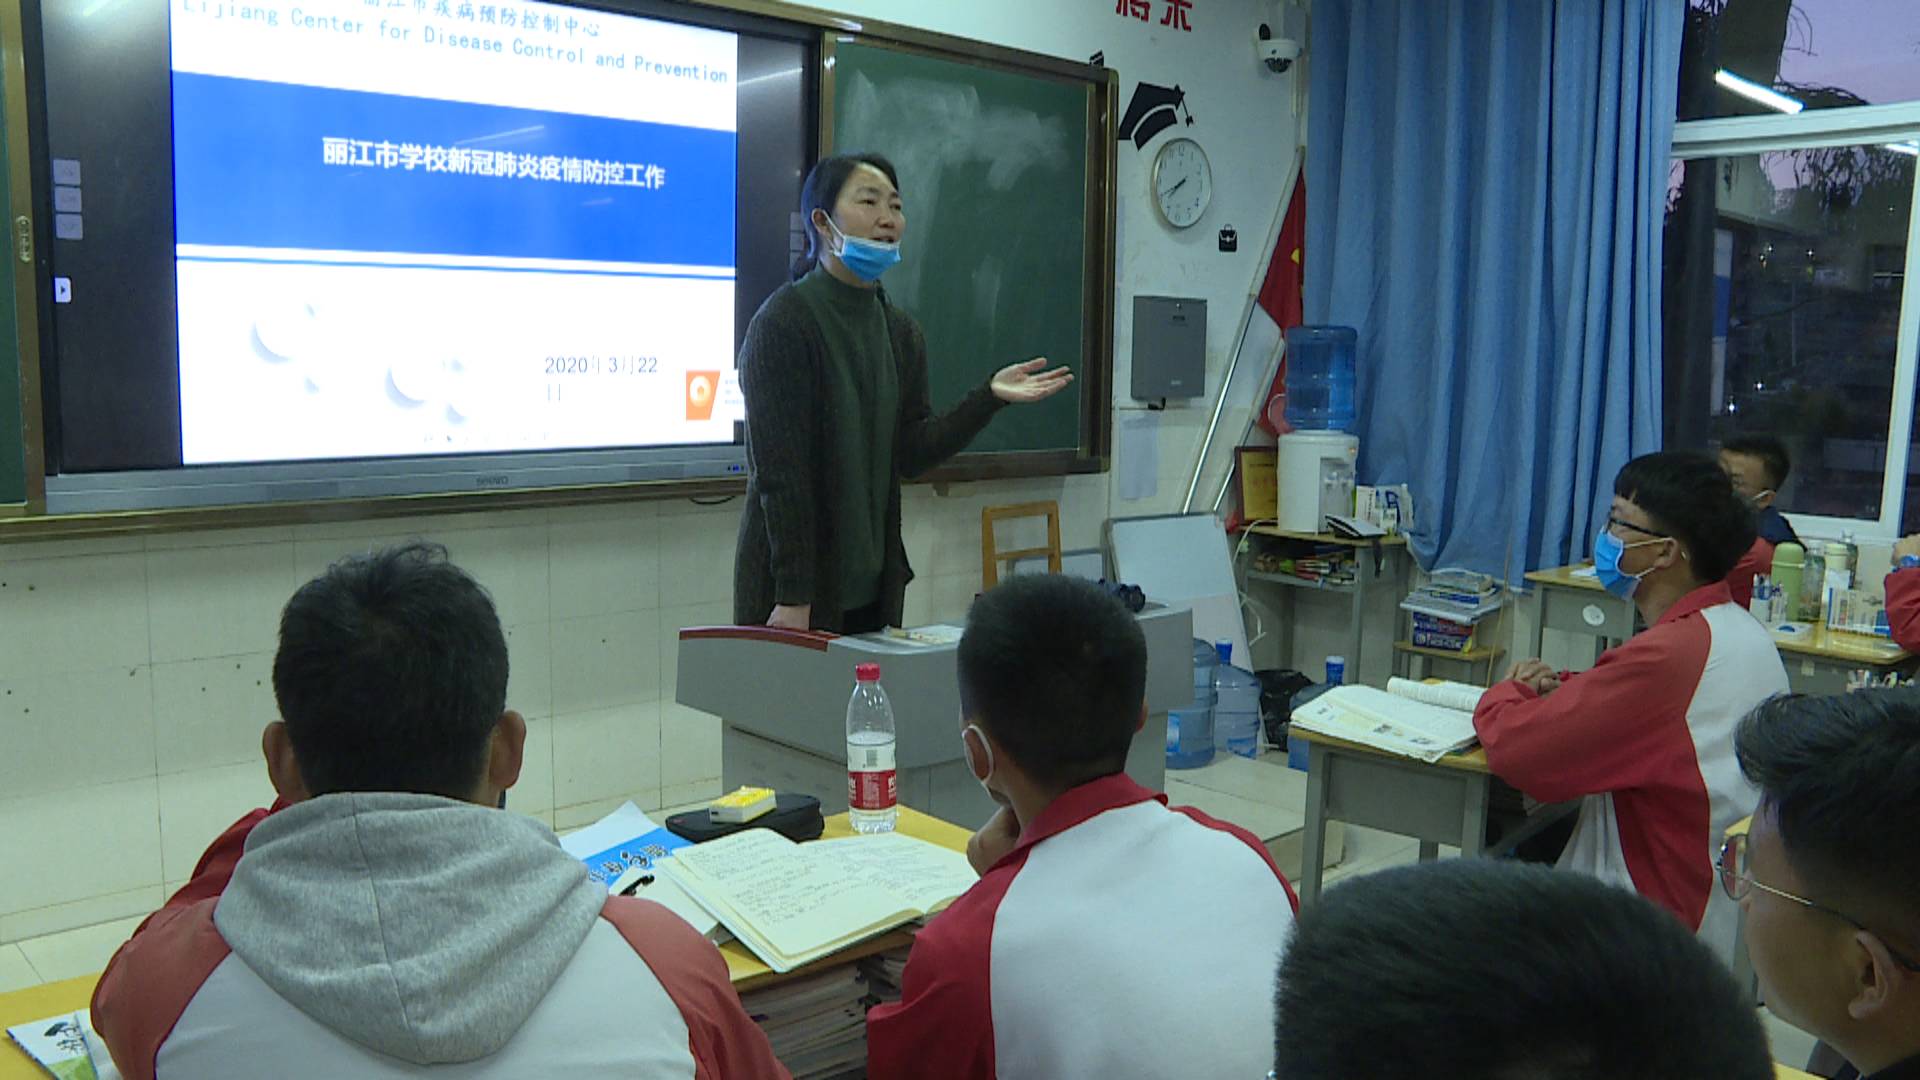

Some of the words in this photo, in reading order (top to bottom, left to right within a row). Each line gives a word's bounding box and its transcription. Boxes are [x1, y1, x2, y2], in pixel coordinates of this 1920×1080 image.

[183, 0, 278, 26] Lijiang
[291, 8, 364, 33] Center
[380, 20, 410, 41] for
[424, 25, 503, 53] Disease
[512, 38, 583, 64] Control
[596, 53, 625, 69] and
[634, 56, 728, 83] Prevention
[322, 137, 666, 189] 丽江市学校新冠肺炎疫情防控工作
